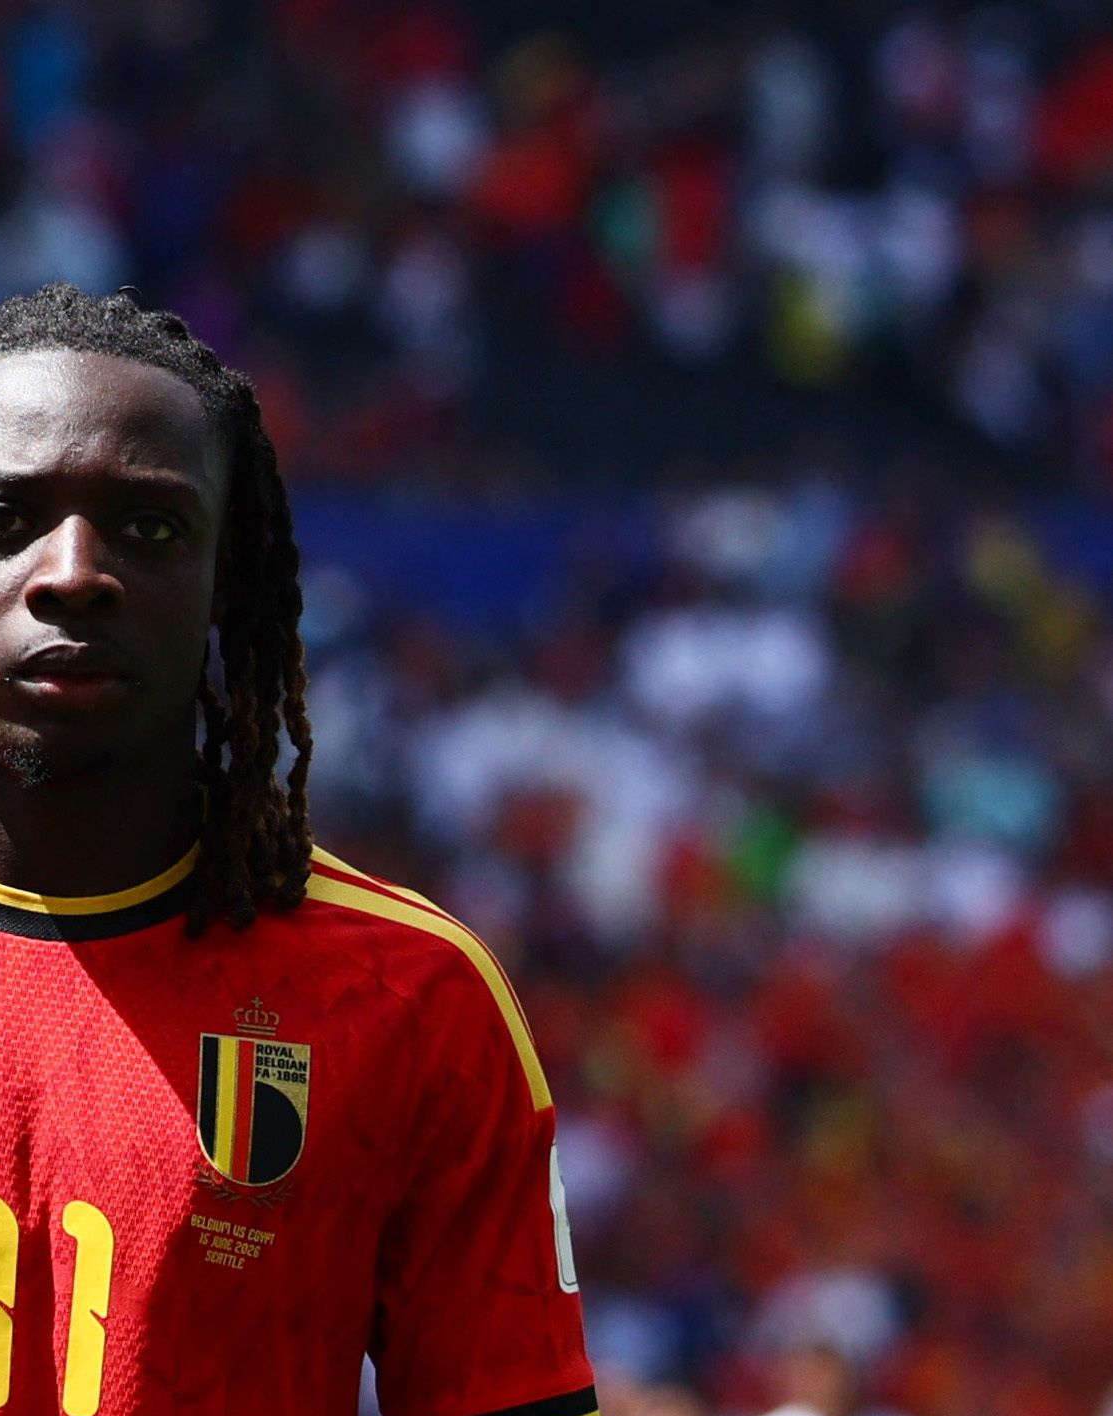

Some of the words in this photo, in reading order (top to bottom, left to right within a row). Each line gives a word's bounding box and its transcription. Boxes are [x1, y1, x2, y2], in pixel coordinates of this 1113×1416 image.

[256, 1044, 294, 1058] ROYAL
[255, 1067, 270, 1079] FA
[256, 1056, 307, 1072] BELGIAN
[190, 1214, 231, 1234] BELGIUM
[247, 1228, 276, 1246] EGYPT
[198, 1232, 210, 1246] 15
[210, 1235, 234, 1251] JUNE
[234, 1241, 261, 1258] 2026
[204, 1249, 246, 1270] SEATTLE
